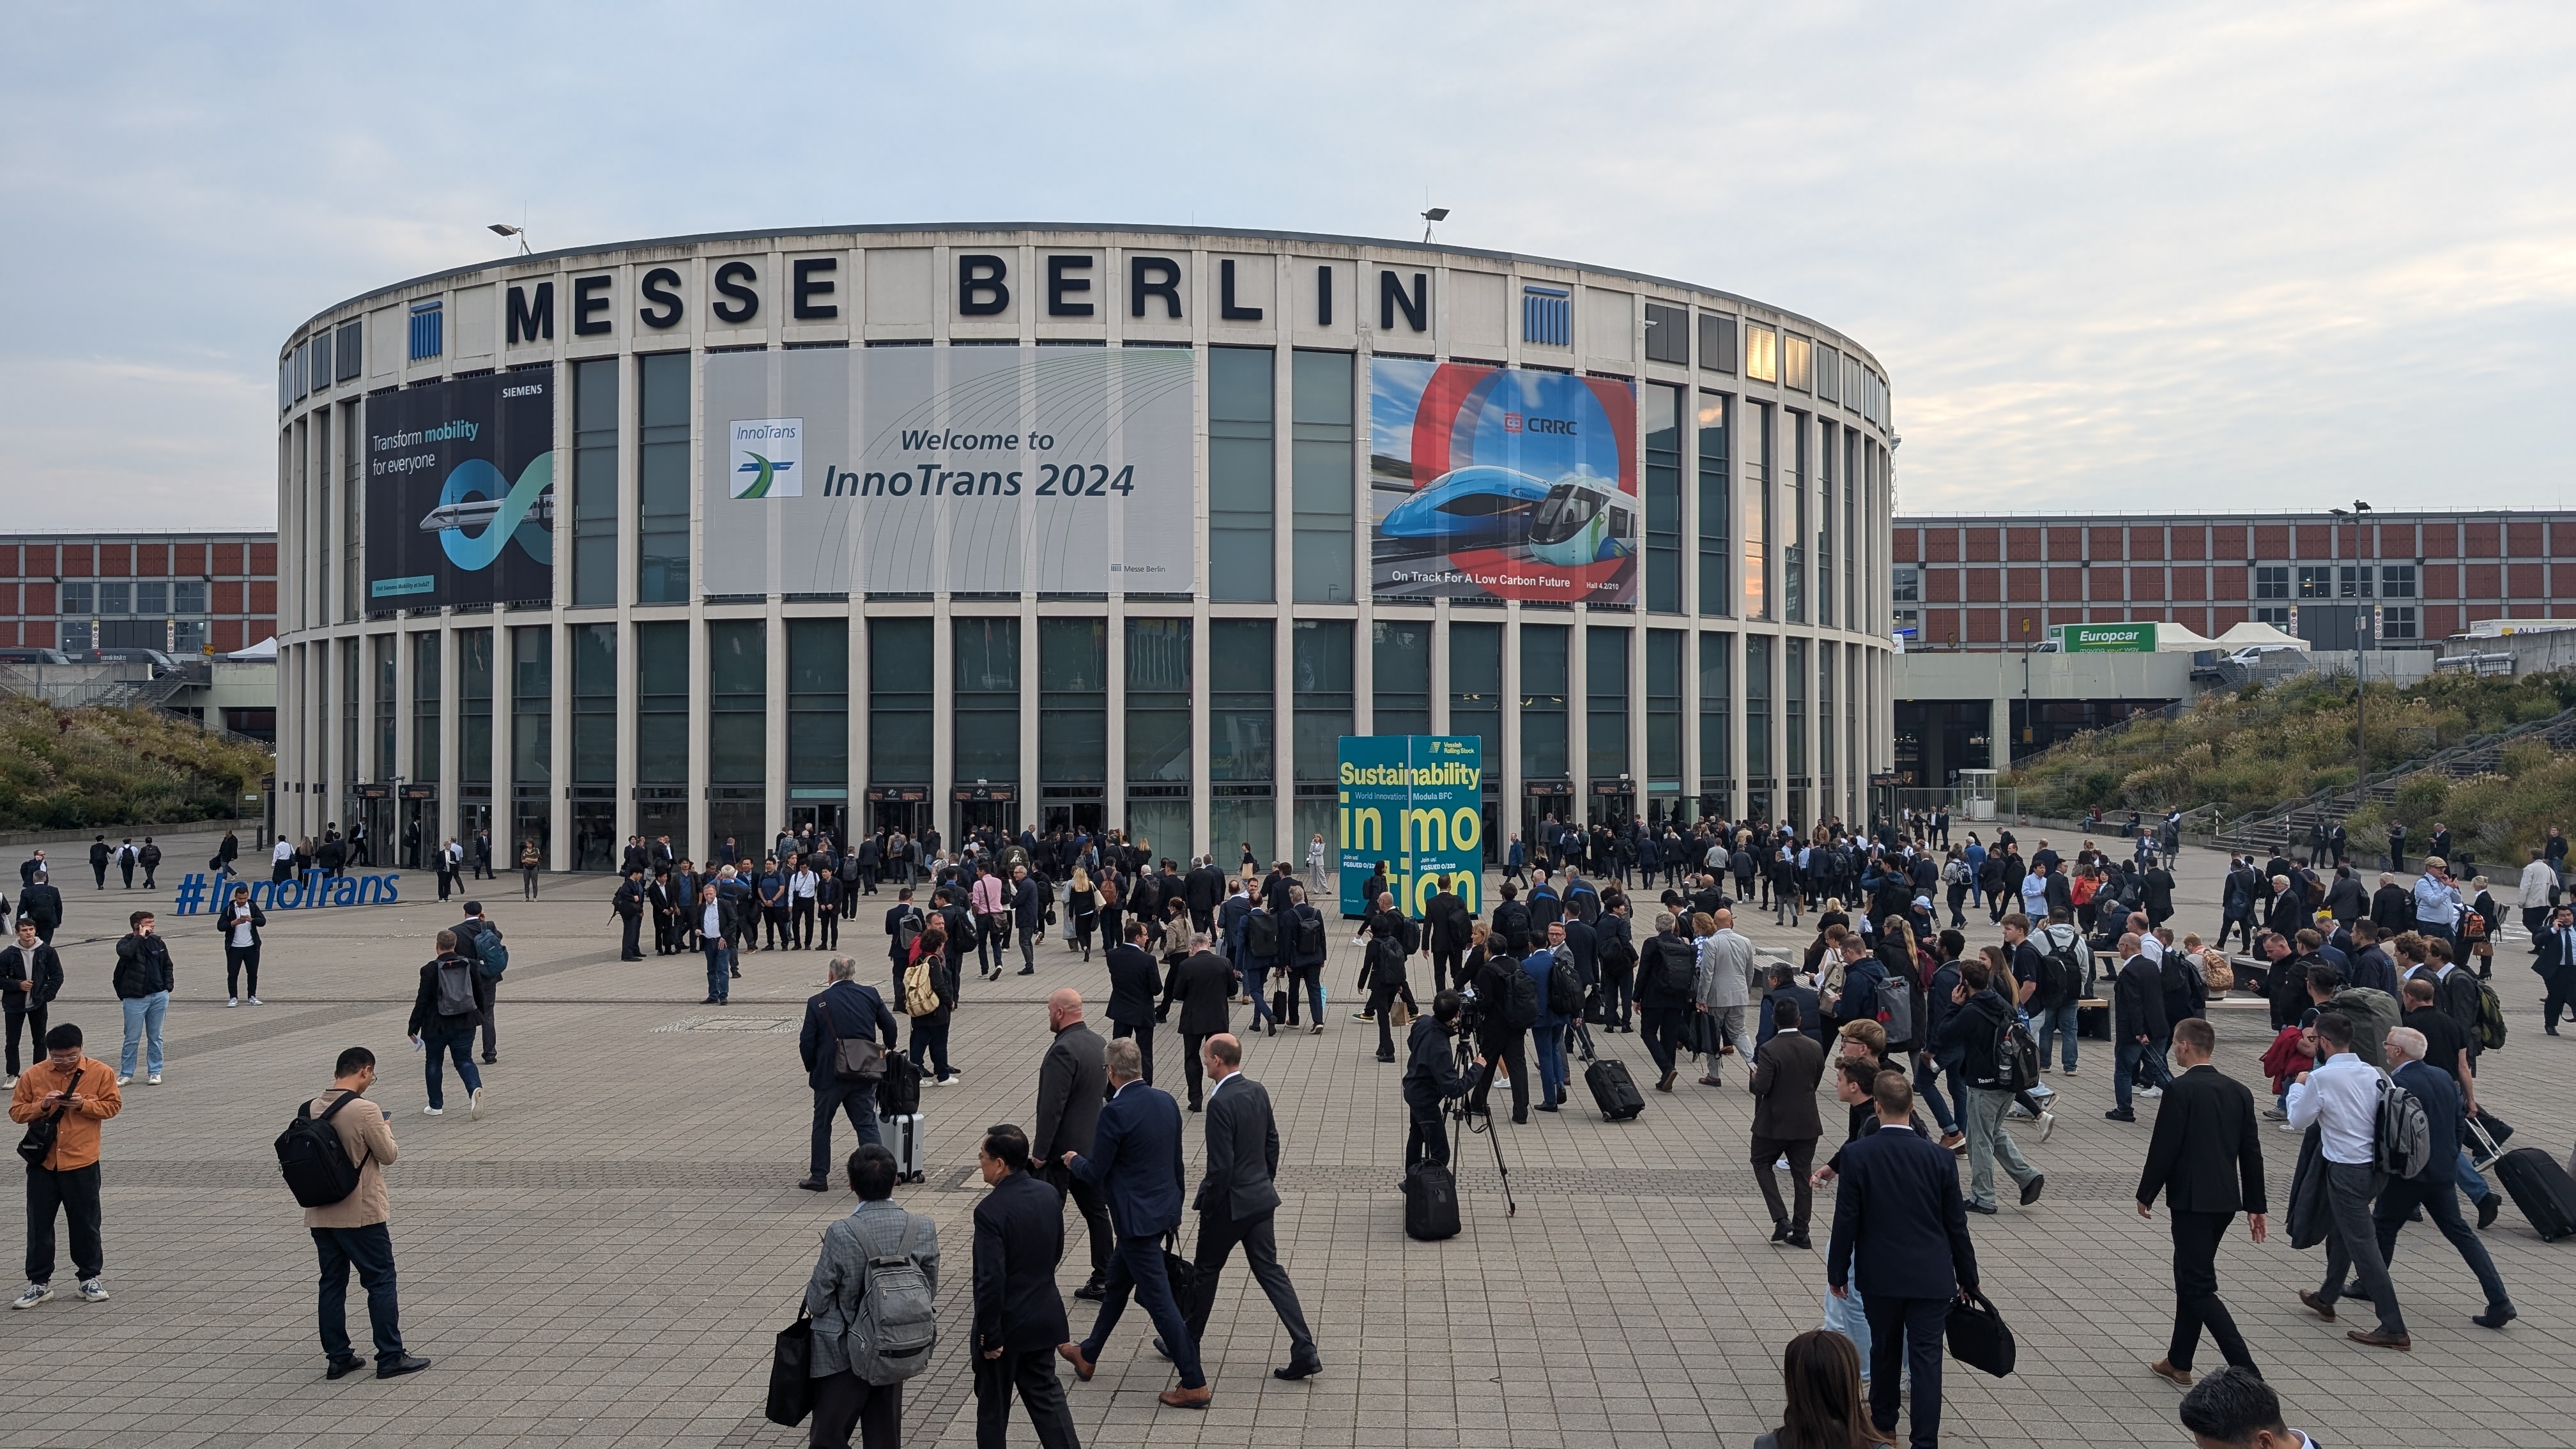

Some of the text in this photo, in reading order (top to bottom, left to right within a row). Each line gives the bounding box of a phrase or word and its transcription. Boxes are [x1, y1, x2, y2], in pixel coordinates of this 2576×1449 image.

[507, 254, 1427, 343] MESSE BERLIN
[502, 385, 542, 399] SIEMENS
[372, 419, 479, 452] Transform mobility
[737, 424, 796, 440] InnoTrans
[1528, 417, 1577, 436] CRRC
[901, 430, 1054, 451] Welcome to
[372, 454, 435, 475] for everyone
[824, 464, 1135, 498] InnoTrans 2024
[1146, 565, 1165, 573] Berlin
[1392, 571, 1570, 587] On Track For A Low Carbon Future
[2079, 631, 2139, 644] Europcar
[1340, 762, 1480, 790] Sustainability
[1355, 792, 1373, 800] World
[1374, 792, 1407, 801] Innovation:
[1413, 792, 1438, 801] Modula
[1340, 792, 1480, 852] in mo
[174, 868, 400, 914] #InnoTrans
